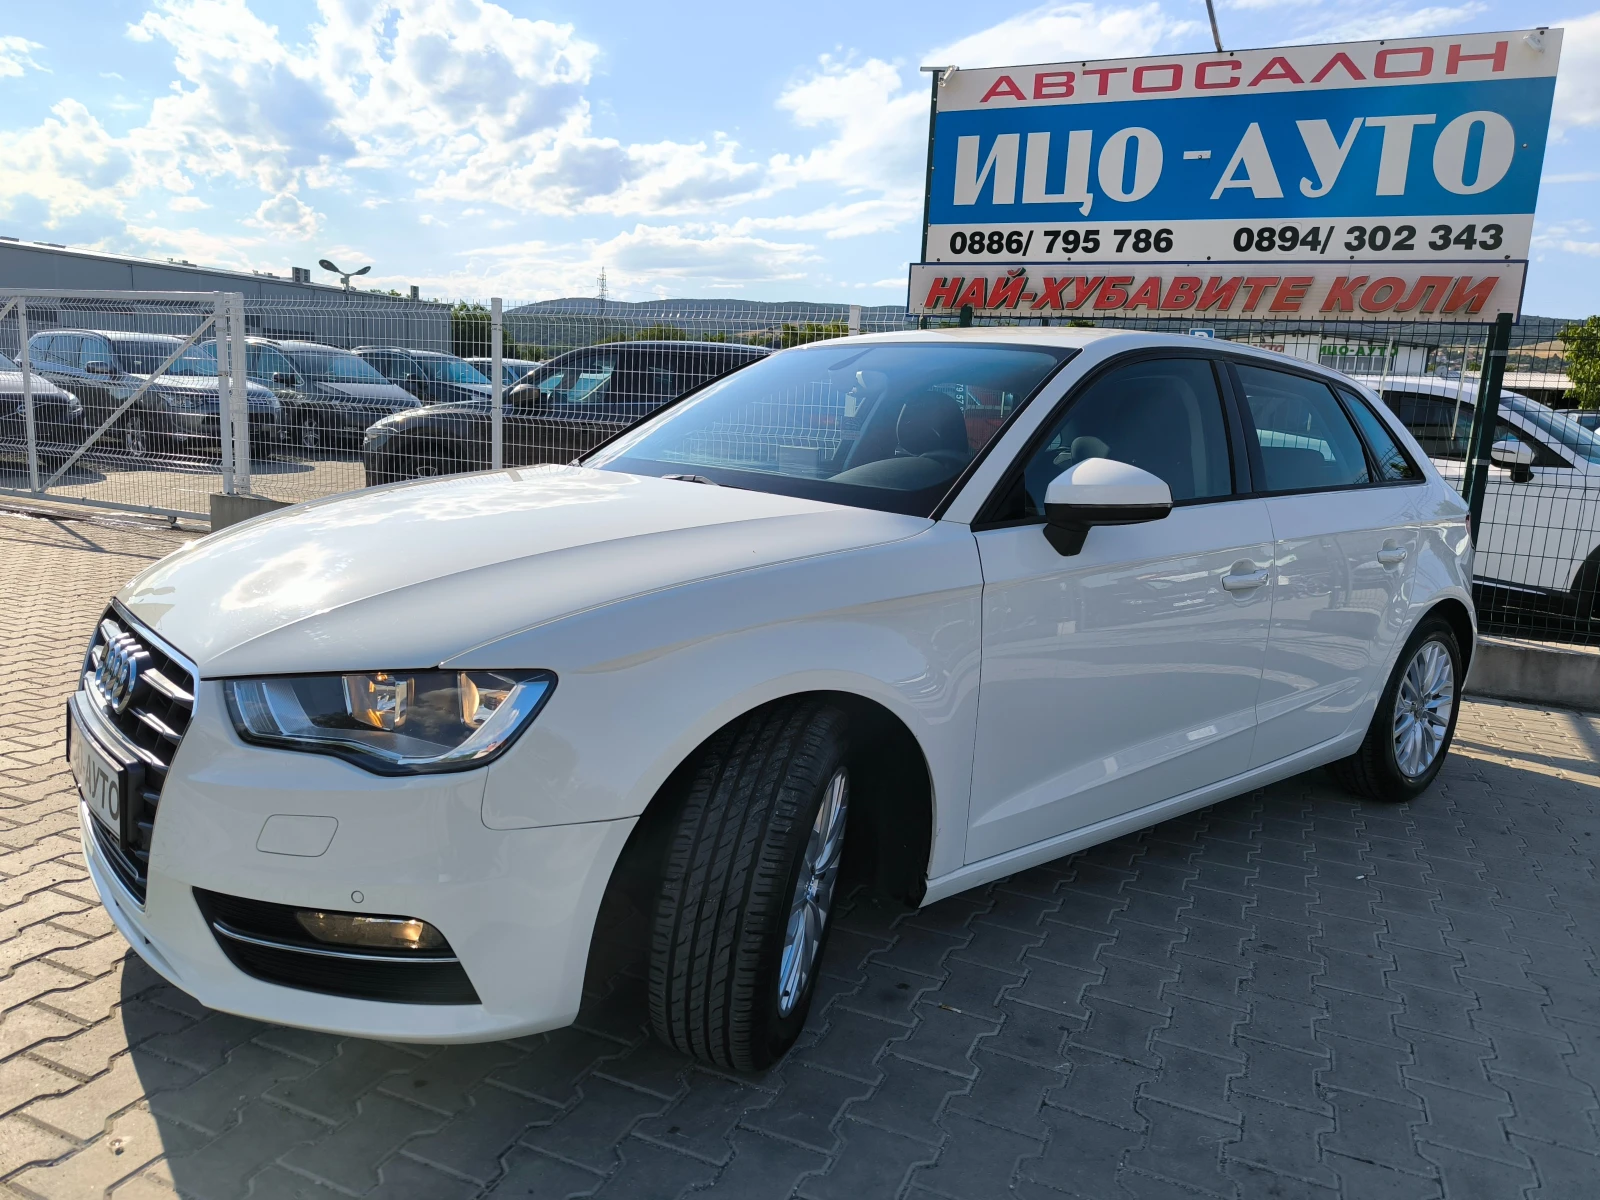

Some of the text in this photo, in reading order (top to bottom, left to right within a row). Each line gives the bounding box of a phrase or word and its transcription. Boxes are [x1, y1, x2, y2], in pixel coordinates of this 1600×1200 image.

[980, 41, 1509, 103] АВТОСАЛОН
[950, 228, 1174, 256] 0886/ 795 786
[1233, 223, 1504, 254] 0894/ 302 343
[923, 267, 1501, 314] НАЙ-ХУБАВИТЕ КОЛИ
